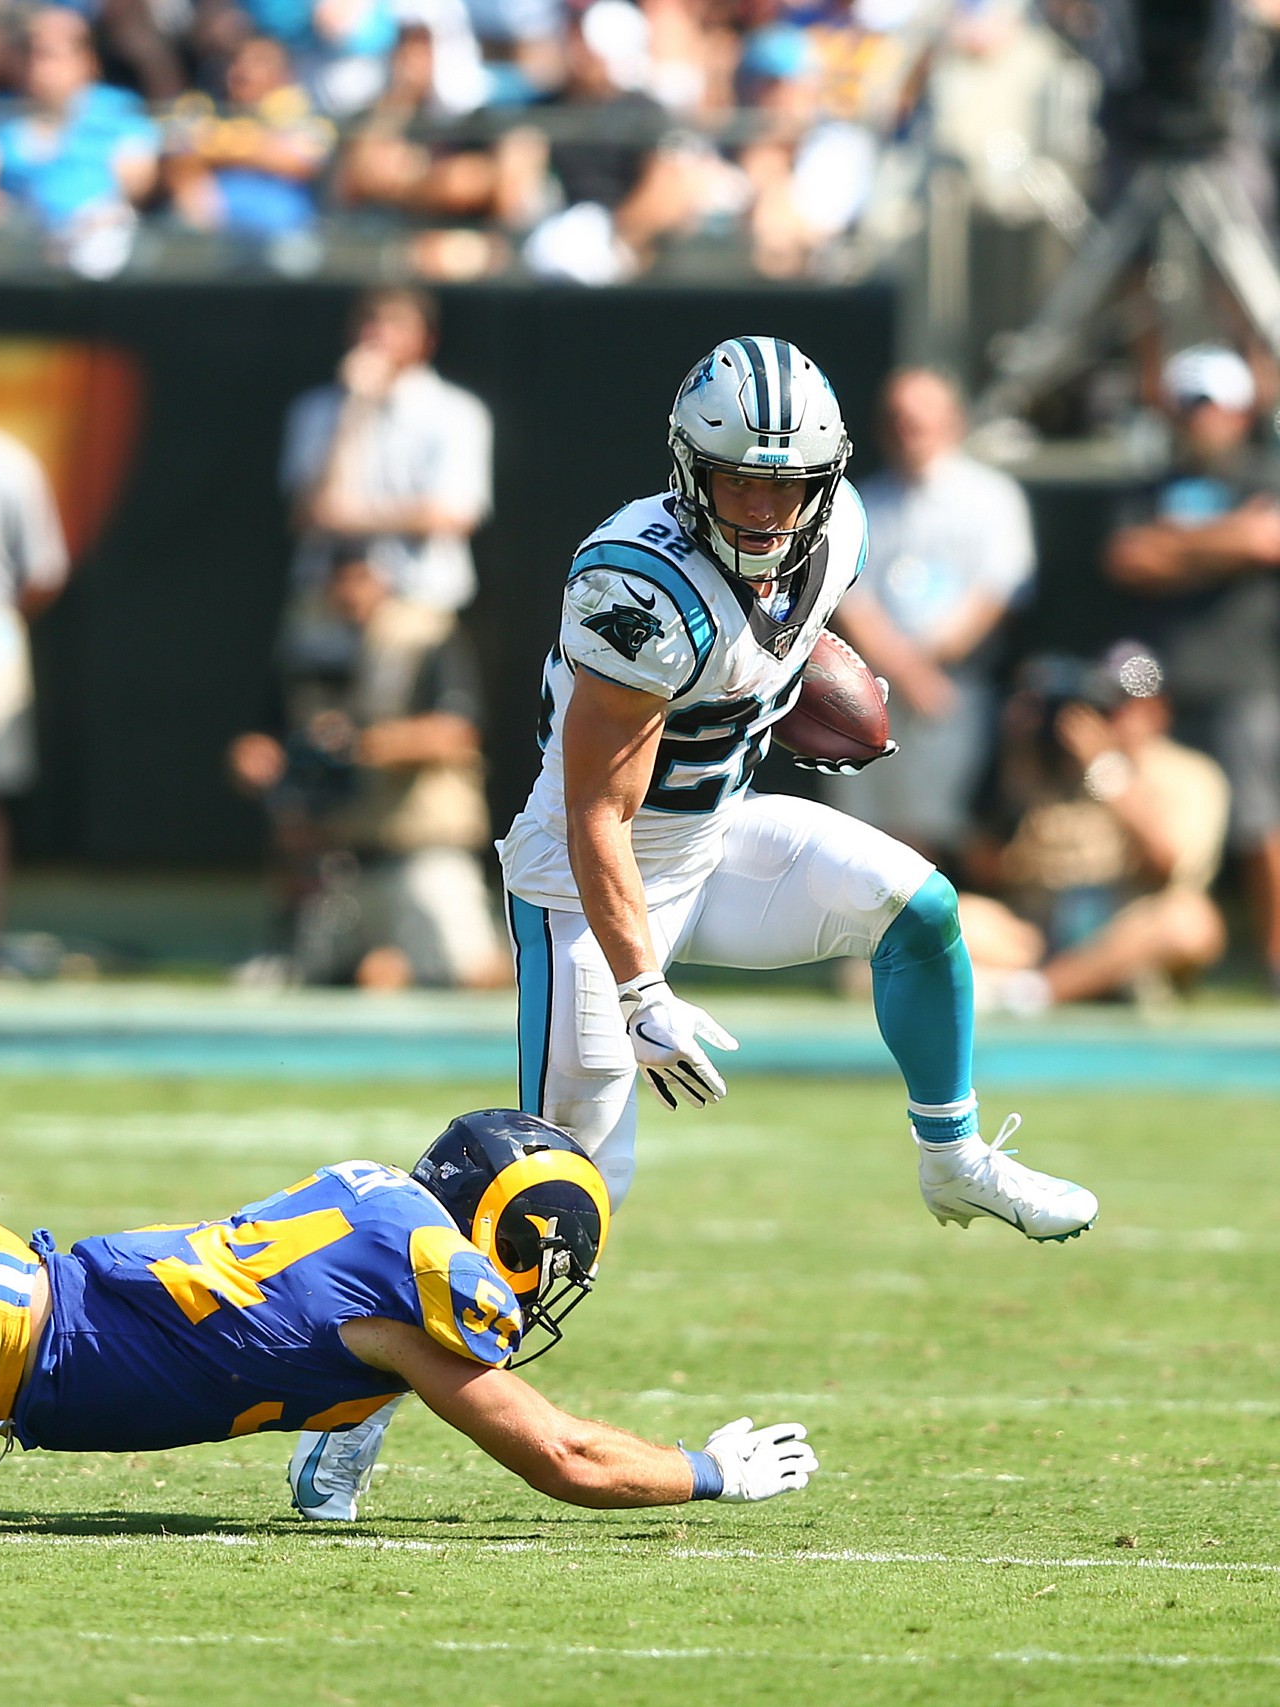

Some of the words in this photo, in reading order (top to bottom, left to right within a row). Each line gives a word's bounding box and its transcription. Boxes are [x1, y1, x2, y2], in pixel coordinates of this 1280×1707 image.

[637, 522, 695, 562] 22
[123, 1174, 355, 1325] 4
[462, 1278, 522, 1350] 54
